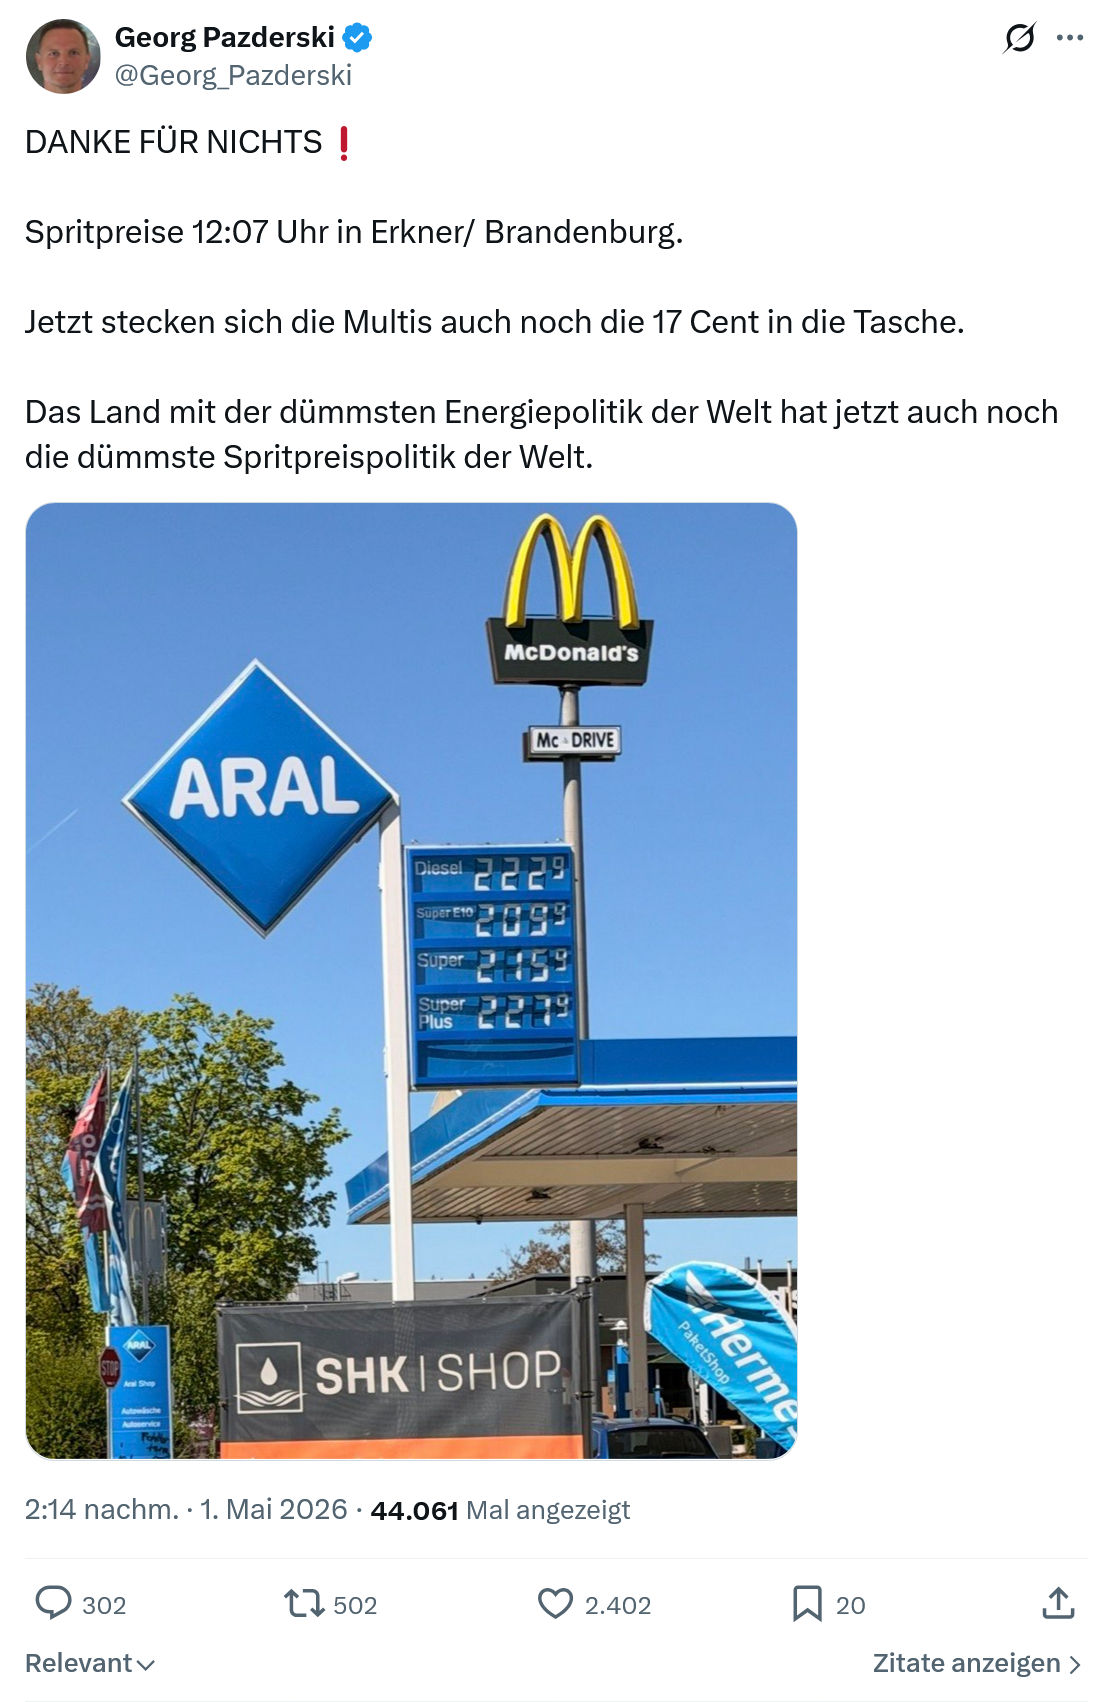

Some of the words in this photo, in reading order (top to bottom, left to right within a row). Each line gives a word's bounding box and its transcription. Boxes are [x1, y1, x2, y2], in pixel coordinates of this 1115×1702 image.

[504, 643, 640, 663] McDonald's
[536, 732, 559, 748] Mc
[571, 732, 615, 748] DRIVE
[169, 755, 360, 820] ARAL
[414, 860, 463, 876] Diesel
[416, 907, 451, 919] Super
[453, 907, 474, 918] E10
[417, 952, 465, 970] Super
[418, 997, 466, 1013] Super
[419, 1014, 453, 1030] Plus
[127, 1340, 151, 1350] ARAL
[677, 1320, 731, 1385] PaketShop
[101, 1360, 119, 1377] STOP
[316, 1355, 409, 1395] SHK
[438, 1350, 561, 1392] SHOP
[139, 1380, 156, 1389] Shop
